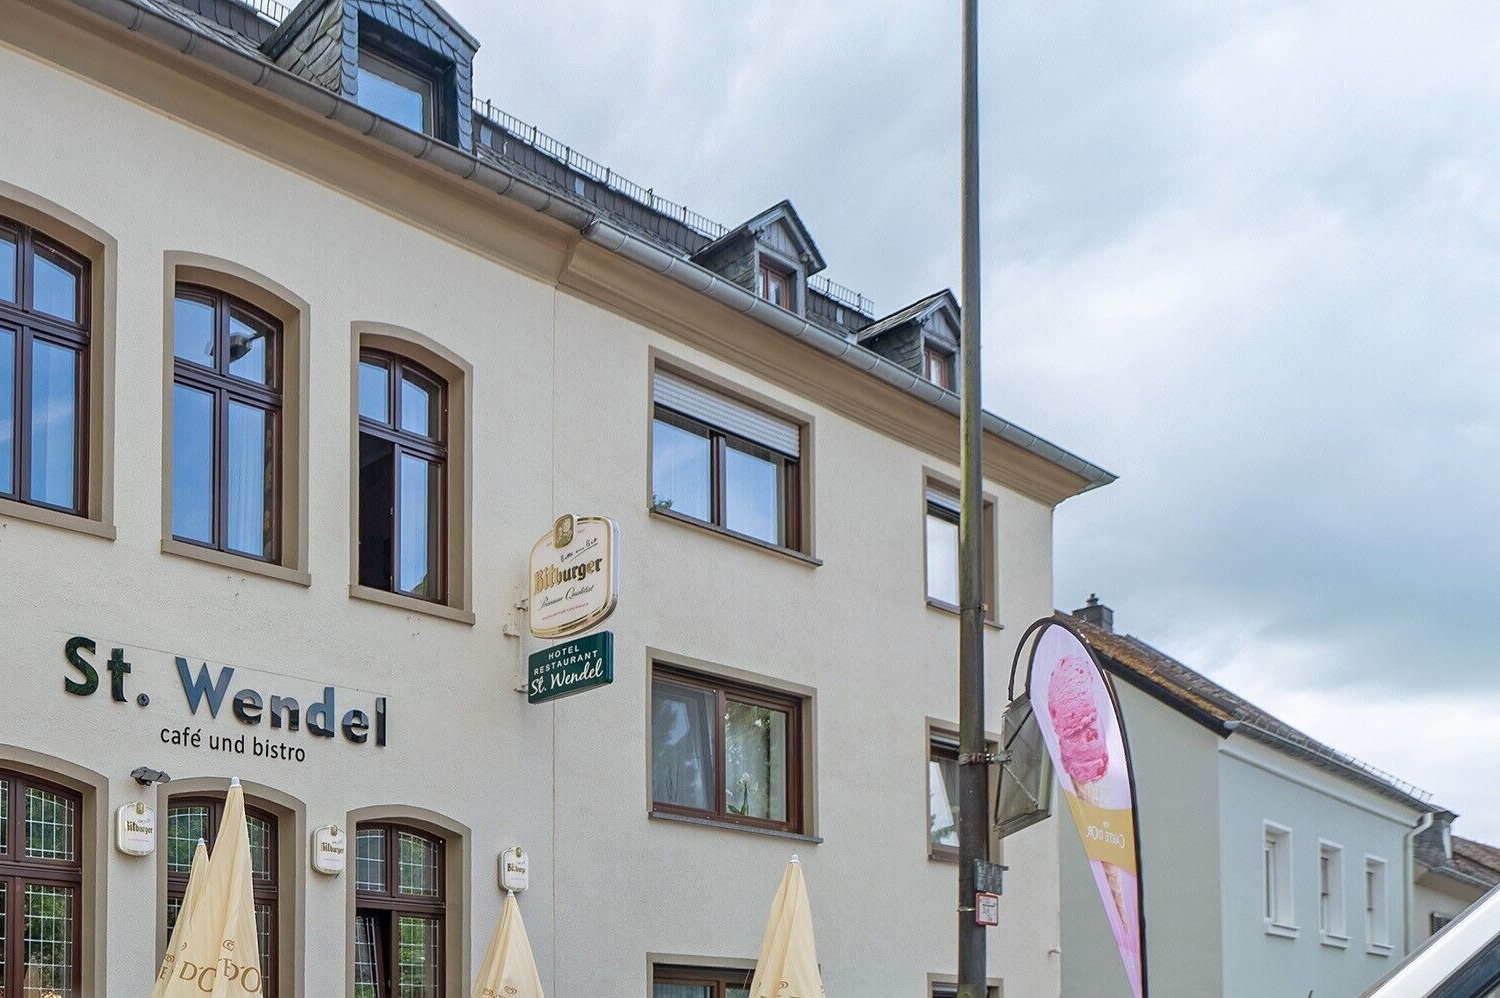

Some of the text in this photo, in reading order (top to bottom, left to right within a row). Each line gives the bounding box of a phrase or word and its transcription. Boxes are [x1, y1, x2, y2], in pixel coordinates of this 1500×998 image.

[533, 557, 603, 595] Bitburger
[533, 650, 598, 676] RESTAURANT
[548, 645, 580, 660] HOTEL
[64, 636, 387, 747] St. Wendel
[530, 657, 604, 697] St. Wendel
[160, 727, 306, 762] café und bistro
